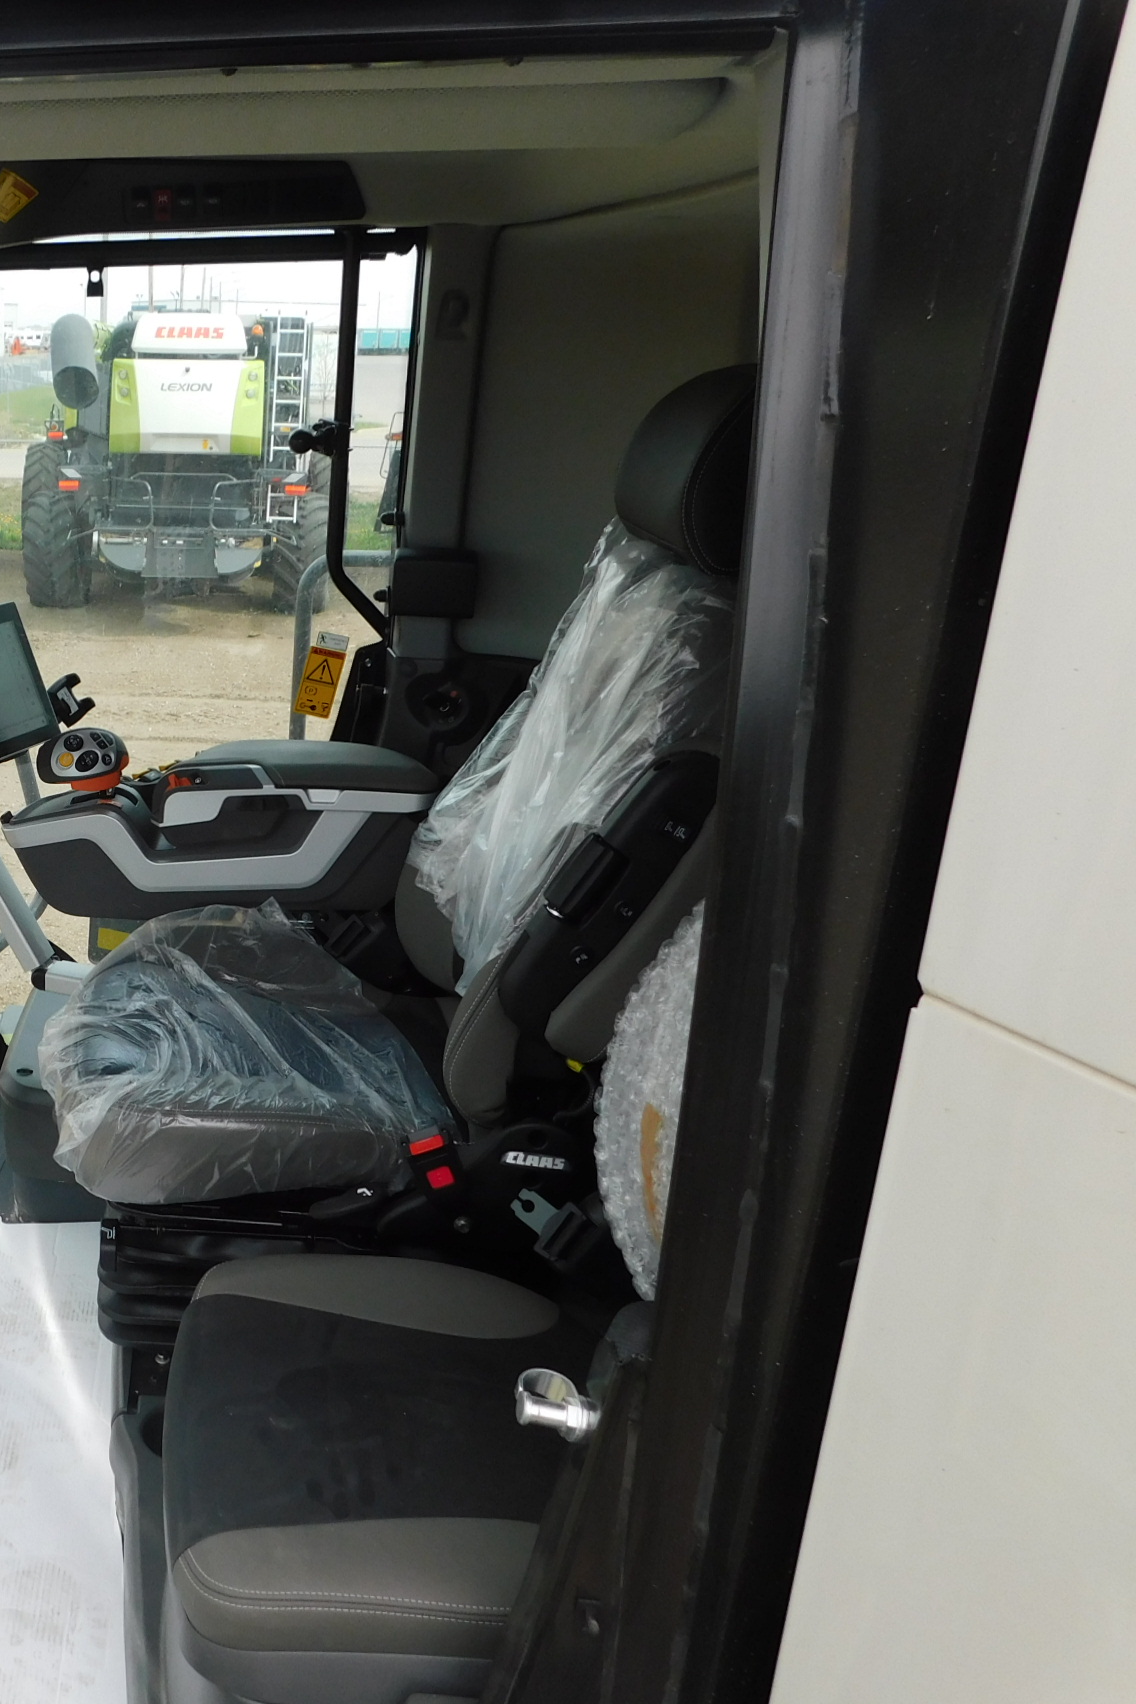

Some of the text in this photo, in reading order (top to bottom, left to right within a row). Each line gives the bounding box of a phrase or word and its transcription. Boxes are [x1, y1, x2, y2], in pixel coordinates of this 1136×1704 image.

[155, 327, 224, 339] CLAAS
[160, 383, 212, 392] LEXION
[505, 1151, 566, 1170] CLAAS
